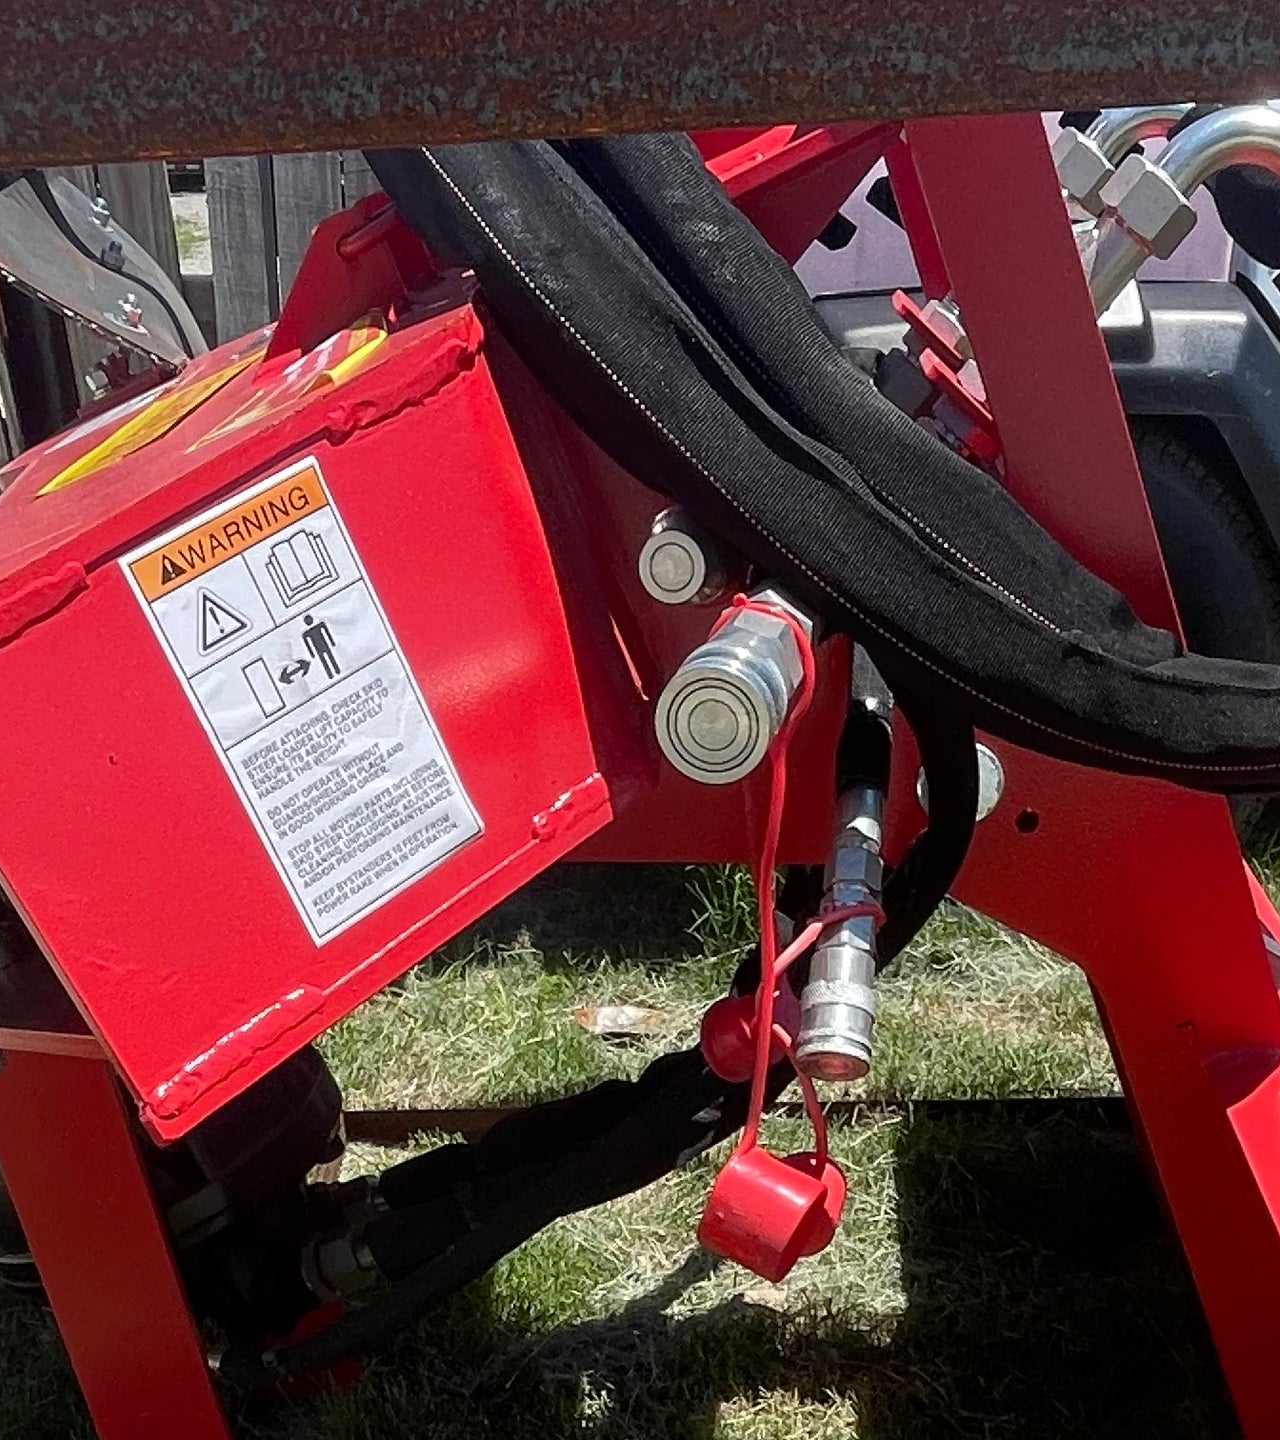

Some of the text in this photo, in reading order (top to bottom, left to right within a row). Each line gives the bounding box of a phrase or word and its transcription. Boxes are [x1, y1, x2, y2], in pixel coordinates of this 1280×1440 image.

[178, 486, 310, 569] WARNING
[241, 740, 279, 769] BEFORE
[331, 690, 361, 714] CHECK
[246, 687, 388, 780] STEER LOADER LIFT CAPACITY TO
[252, 762, 288, 789] ENSURE
[304, 731, 338, 757] ABILITY
[337, 723, 351, 736] TO
[351, 702, 383, 728] SAFELY
[347, 771, 356, 782] IN
[357, 754, 385, 776] PLACE
[385, 741, 404, 758] AND
[257, 771, 294, 799] HANDLE
[293, 760, 312, 776] THE
[266, 742, 381, 819] DO NOT OPERATE WITHOUT
[277, 827, 287, 839] IN
[287, 811, 314, 833] GOOD
[314, 784, 357, 816] WORKING
[287, 757, 437, 859] STOP ALL MOVING PARTS INCLUDING
[292, 765, 445, 869] SKID STEER LOADER ENGINE BEFORE
[401, 776, 448, 812] ADJUSTING
[312, 887, 336, 908] KEEP
[336, 850, 391, 892] BYSTANDERS
[401, 828, 424, 848] FEET
[424, 812, 449, 834] FROM
[317, 890, 349, 917] POWER
